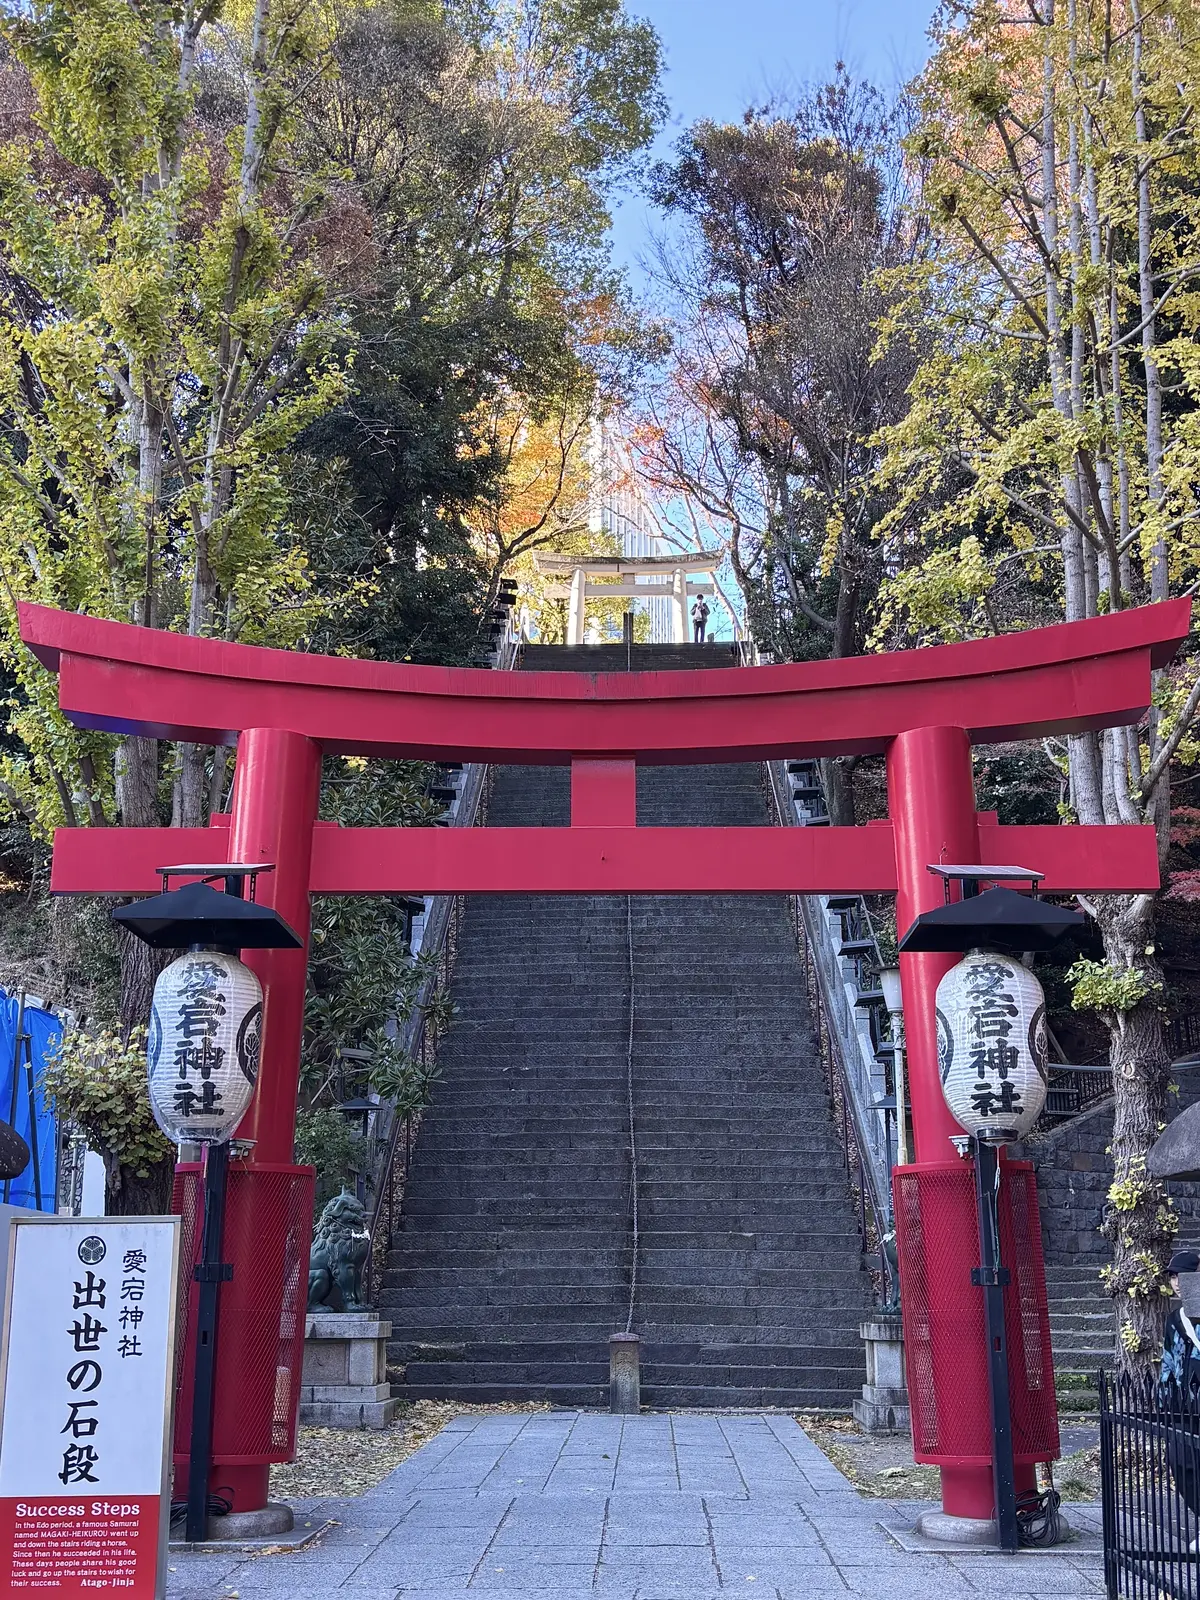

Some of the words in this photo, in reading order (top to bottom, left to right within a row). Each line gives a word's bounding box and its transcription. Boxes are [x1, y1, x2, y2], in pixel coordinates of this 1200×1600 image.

[172, 961, 228, 1117] 愛宕神社
[963, 962, 1024, 1117] 愛宕神社
[117, 1249, 147, 1359] 愛宕神社
[58, 1271, 108, 1486] 出世の石段
[16, 1503, 85, 1517] Success
[91, 1502, 140, 1517] Steps
[36, 1560, 53, 1568] days
[55, 1560, 80, 1568] people
[118, 1559, 136, 1567] good
